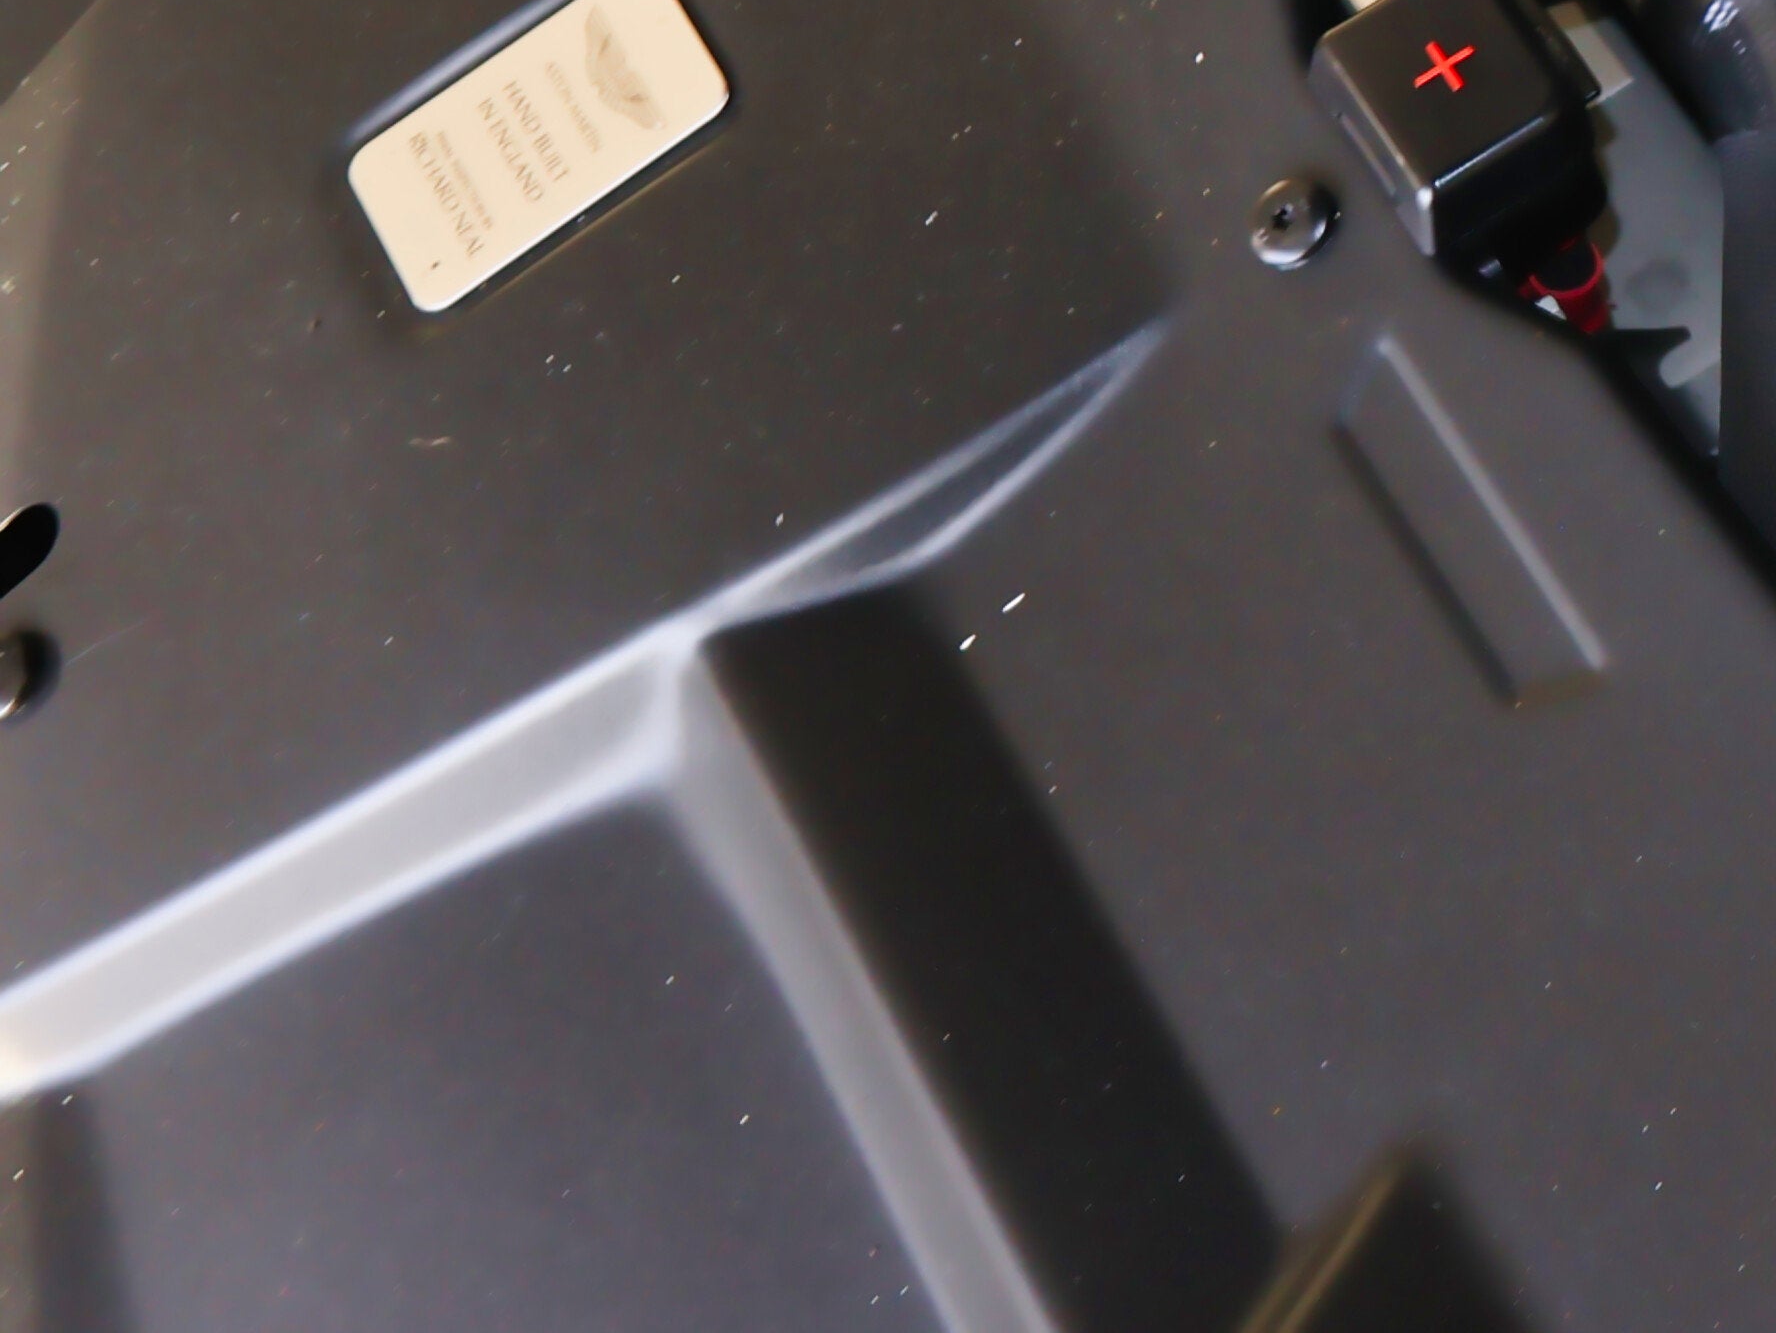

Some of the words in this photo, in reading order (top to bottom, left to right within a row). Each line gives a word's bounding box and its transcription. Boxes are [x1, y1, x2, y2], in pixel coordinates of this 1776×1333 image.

[501, 80, 541, 135] HAND
[477, 98, 495, 120] IN
[487, 119, 545, 204] ENGLAND
